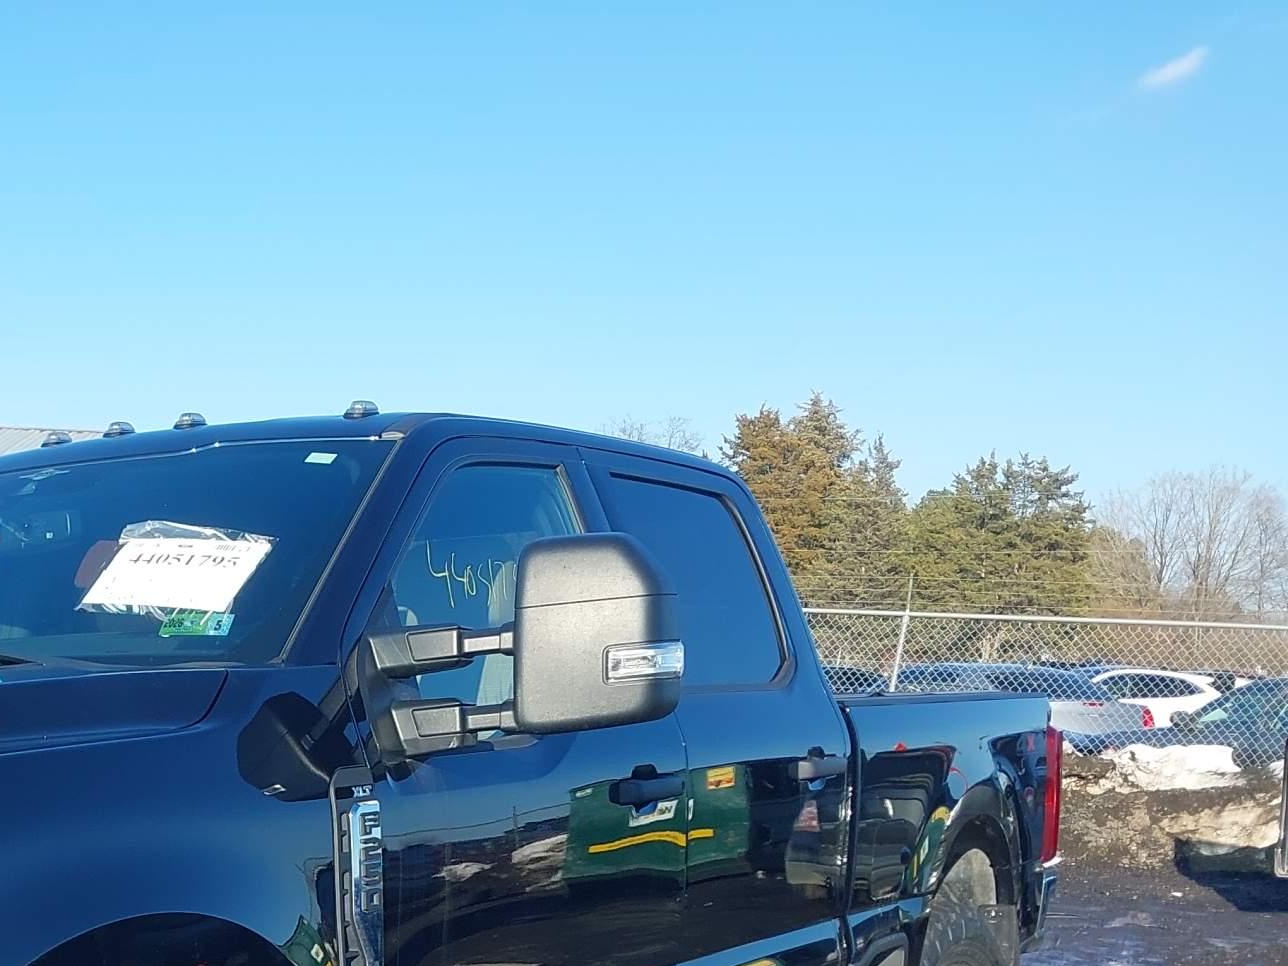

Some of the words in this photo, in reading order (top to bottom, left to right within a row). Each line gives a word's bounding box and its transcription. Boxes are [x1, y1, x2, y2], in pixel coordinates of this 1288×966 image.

[129, 552, 241, 568] 44051795
[213, 619, 224, 631] 5
[351, 785, 373, 798] XLT
